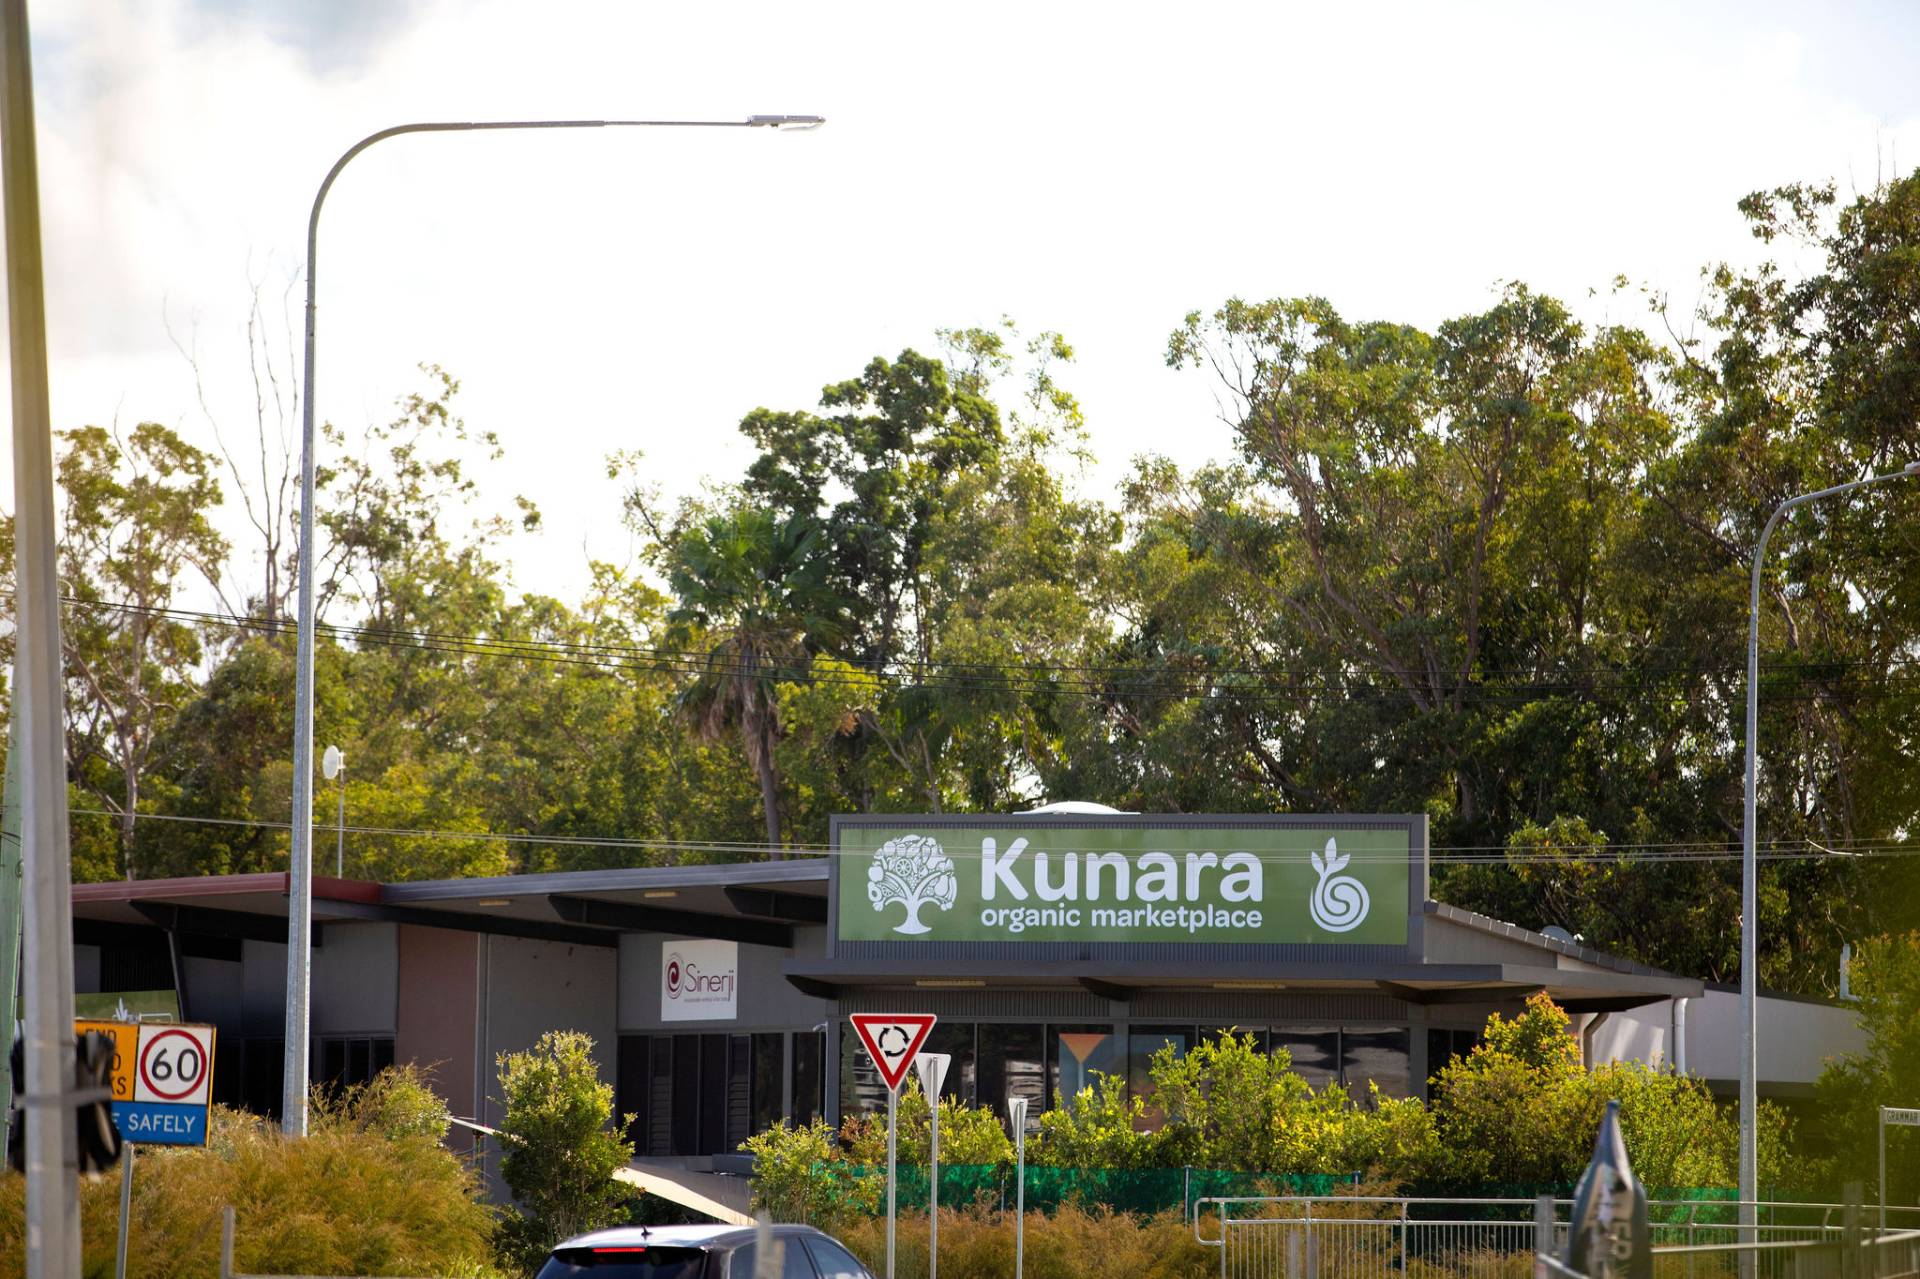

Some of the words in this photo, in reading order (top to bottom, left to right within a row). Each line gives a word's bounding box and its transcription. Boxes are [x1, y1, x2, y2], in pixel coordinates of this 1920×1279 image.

[981, 837, 1263, 901] Kunara
[980, 902, 1081, 933] organic
[1091, 904, 1263, 933] marketplace
[684, 963, 734, 1002] Sinerji
[151, 1047, 199, 1083] 60
[128, 1113, 196, 1133] SAFELY
